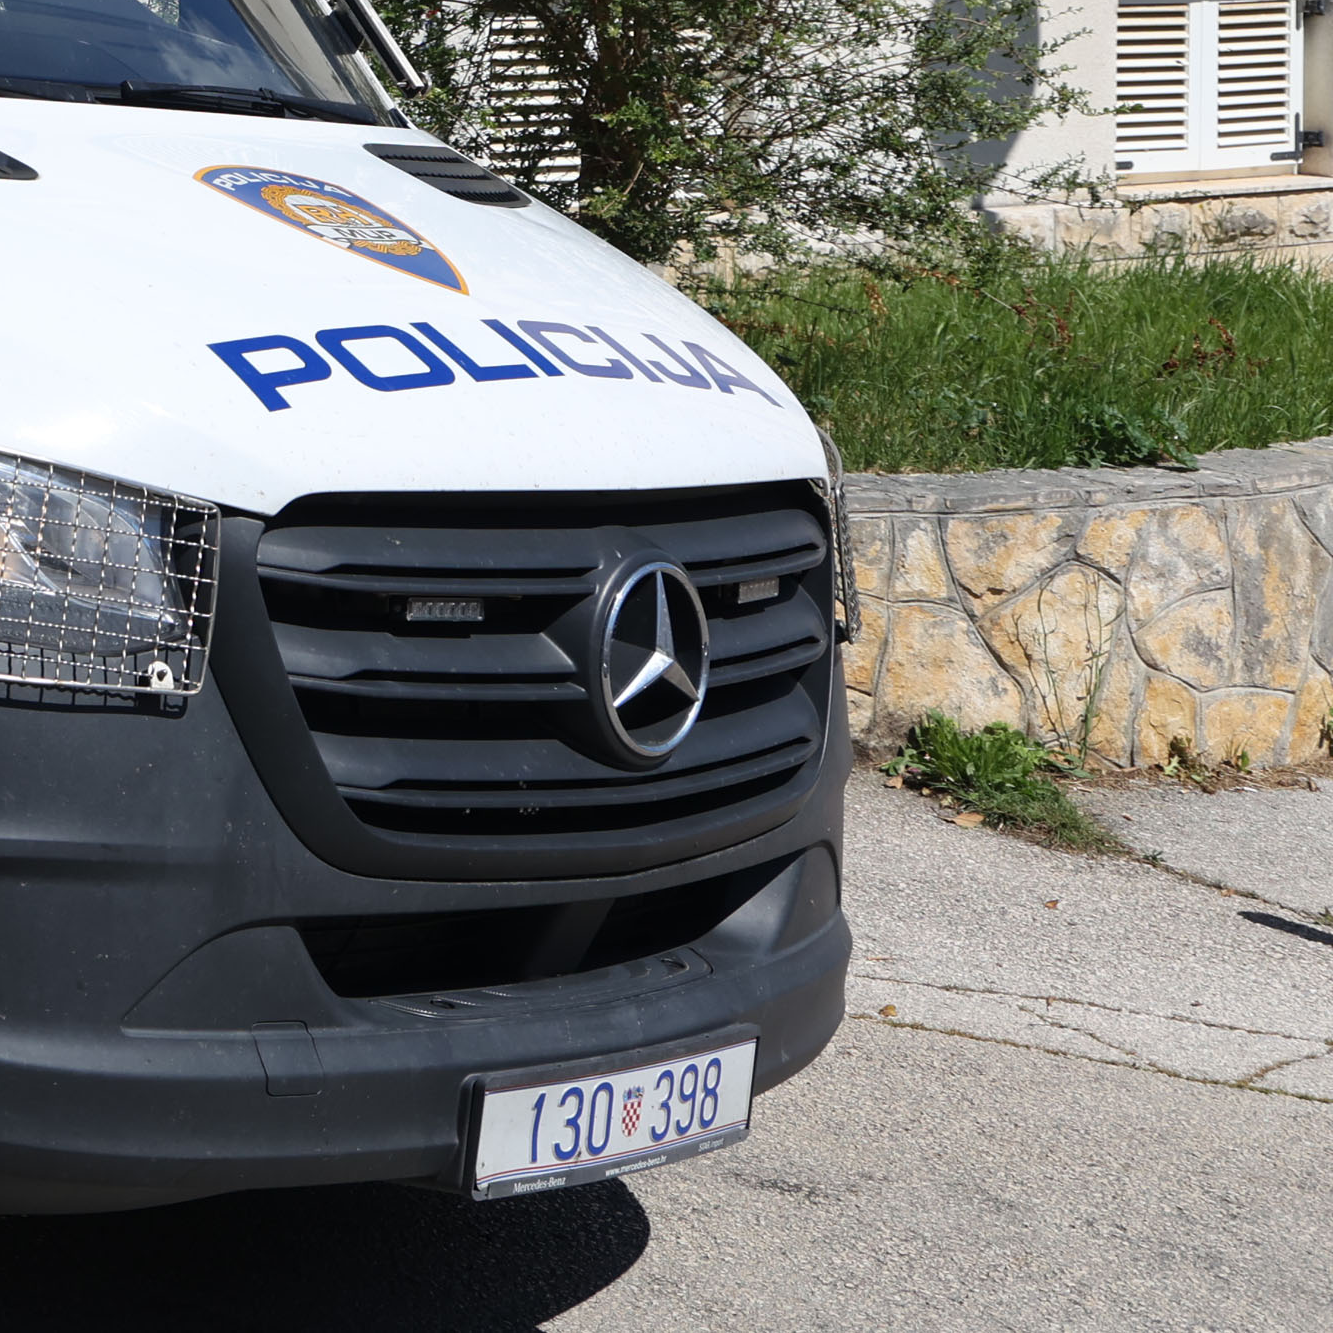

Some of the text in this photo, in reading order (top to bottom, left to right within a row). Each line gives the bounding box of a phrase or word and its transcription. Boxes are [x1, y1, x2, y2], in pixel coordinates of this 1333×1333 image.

[212, 171, 352, 198] POLICIJA
[293, 204, 375, 227] RH
[334, 228, 398, 241] MUP
[207, 319, 785, 412] POLICIJA
[530, 1057, 723, 1164] 130 398
[605, 1154, 668, 1177] www.mercedes-benz.hr
[512, 1176, 567, 1194] Mercedes-Benz
